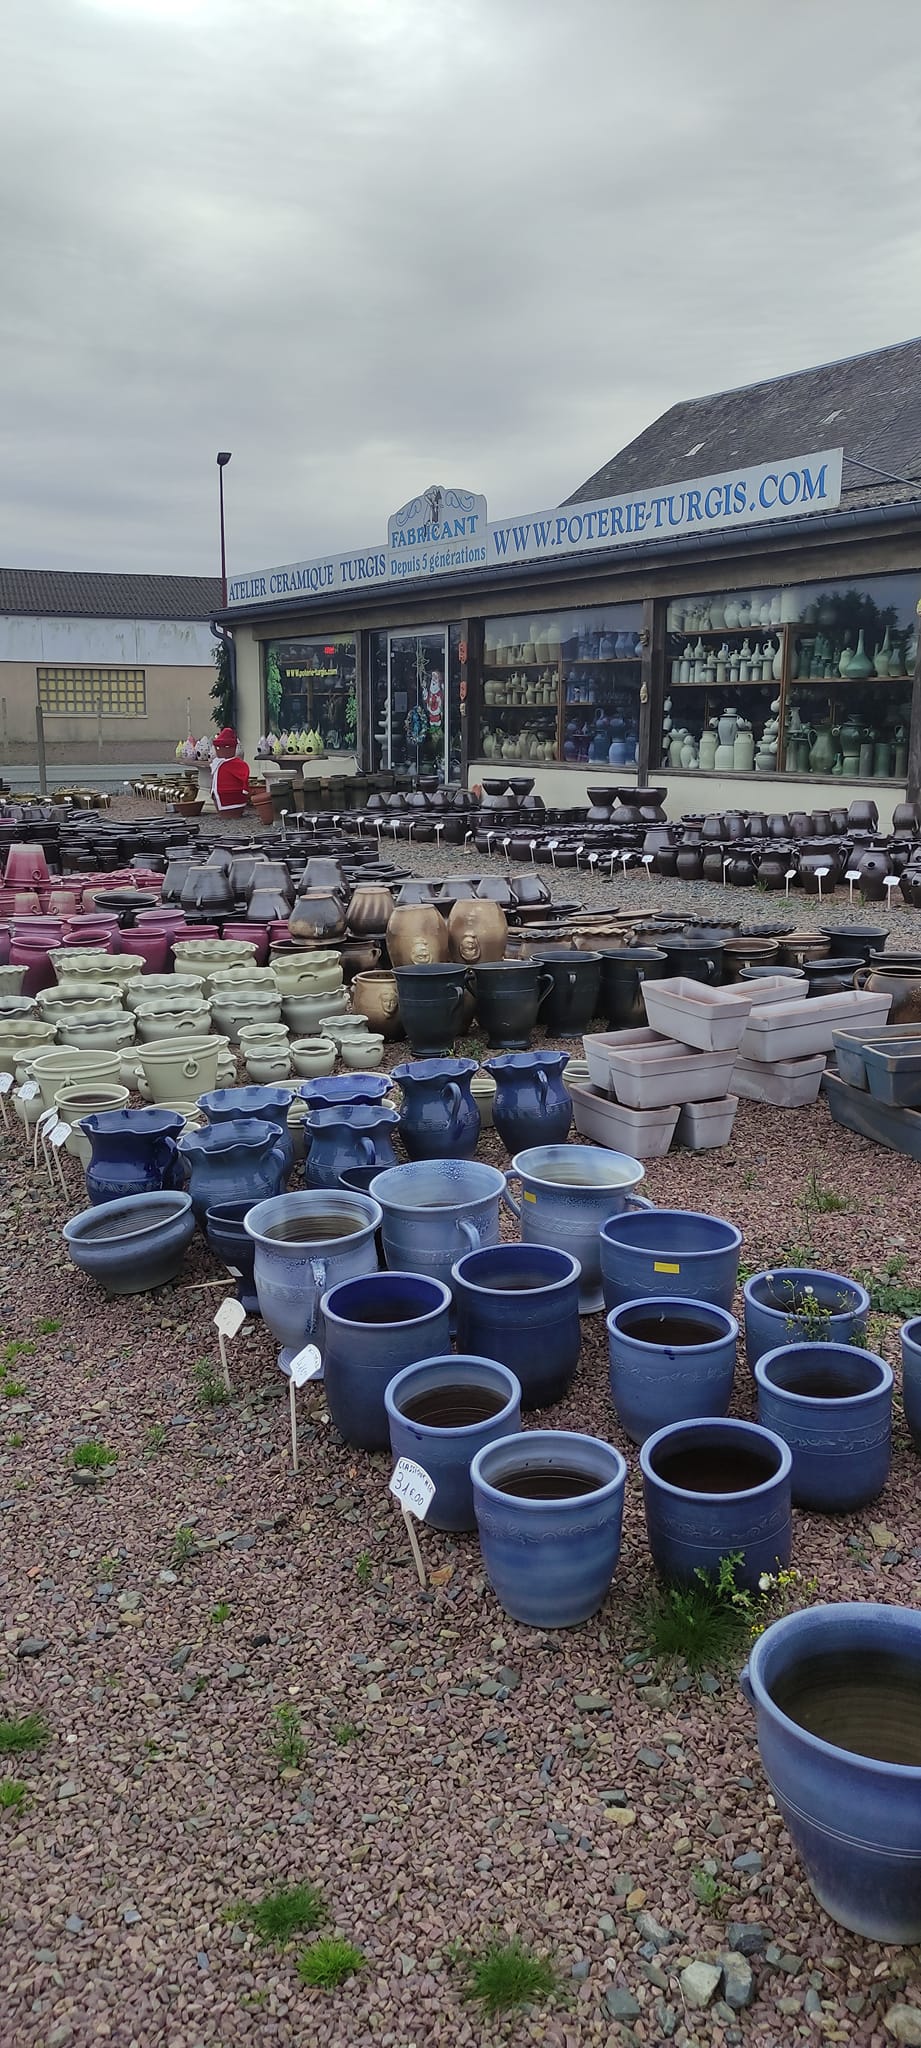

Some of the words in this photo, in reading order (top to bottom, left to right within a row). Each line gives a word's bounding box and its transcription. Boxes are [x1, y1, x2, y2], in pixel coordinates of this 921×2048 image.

[493, 464, 828, 556] WWW.POTERIE-TURGIS.COM
[391, 515, 479, 548] FABRICANT
[229, 578, 267, 601] ATELIER
[269, 564, 334, 593] CERAMIQUE
[339, 553, 386, 581] TURGIS
[391, 557, 420, 577] Depuis
[422, 553, 428, 571] 5
[429, 545, 486, 573] générations
